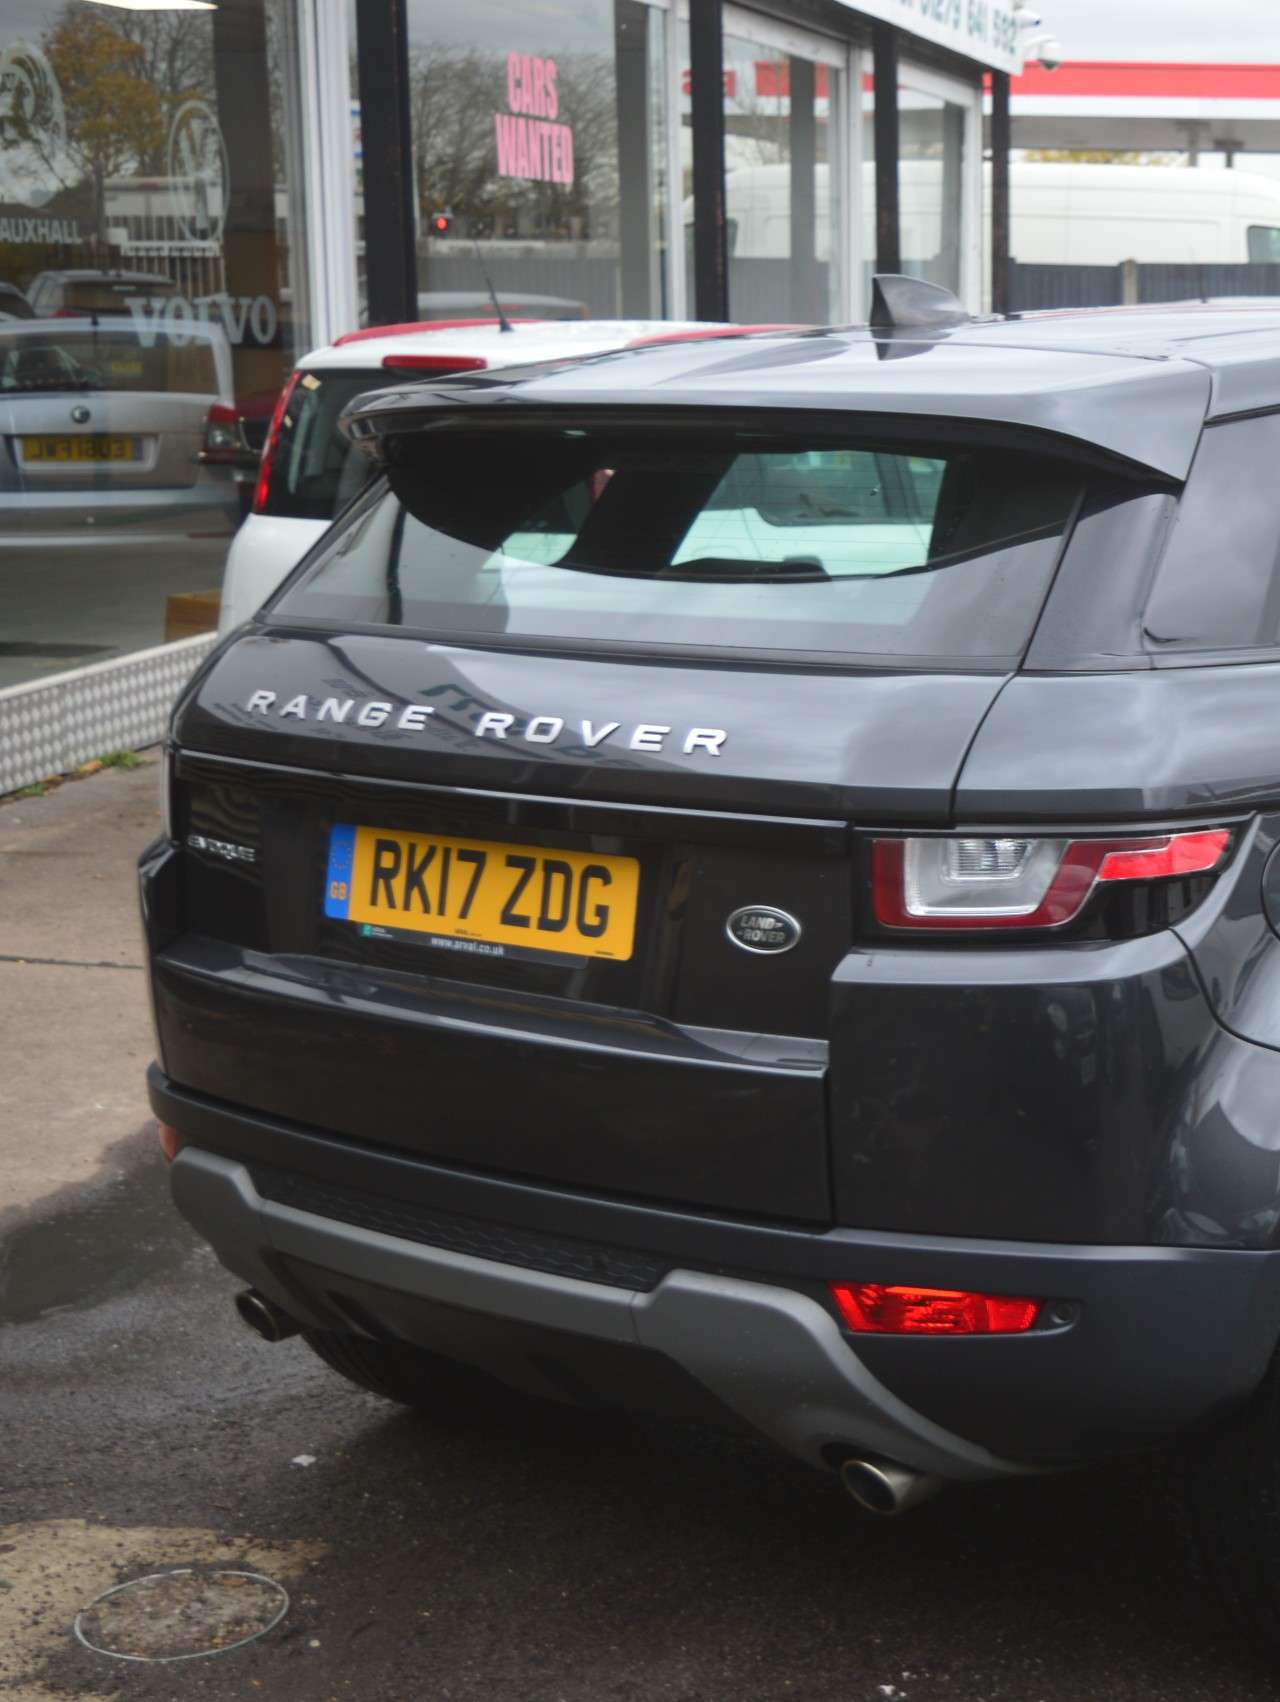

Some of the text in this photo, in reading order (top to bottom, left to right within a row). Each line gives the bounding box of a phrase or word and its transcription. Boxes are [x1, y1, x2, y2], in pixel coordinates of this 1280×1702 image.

[506, 50, 558, 120] CARS
[495, 112, 574, 185] WANTED
[0, 218, 83, 245] AUXHALL
[124, 294, 278, 348] VOLVO
[244, 689, 435, 732] RANGE
[474, 711, 729, 757] ROVER
[369, 838, 613, 939] RK17 ZDG
